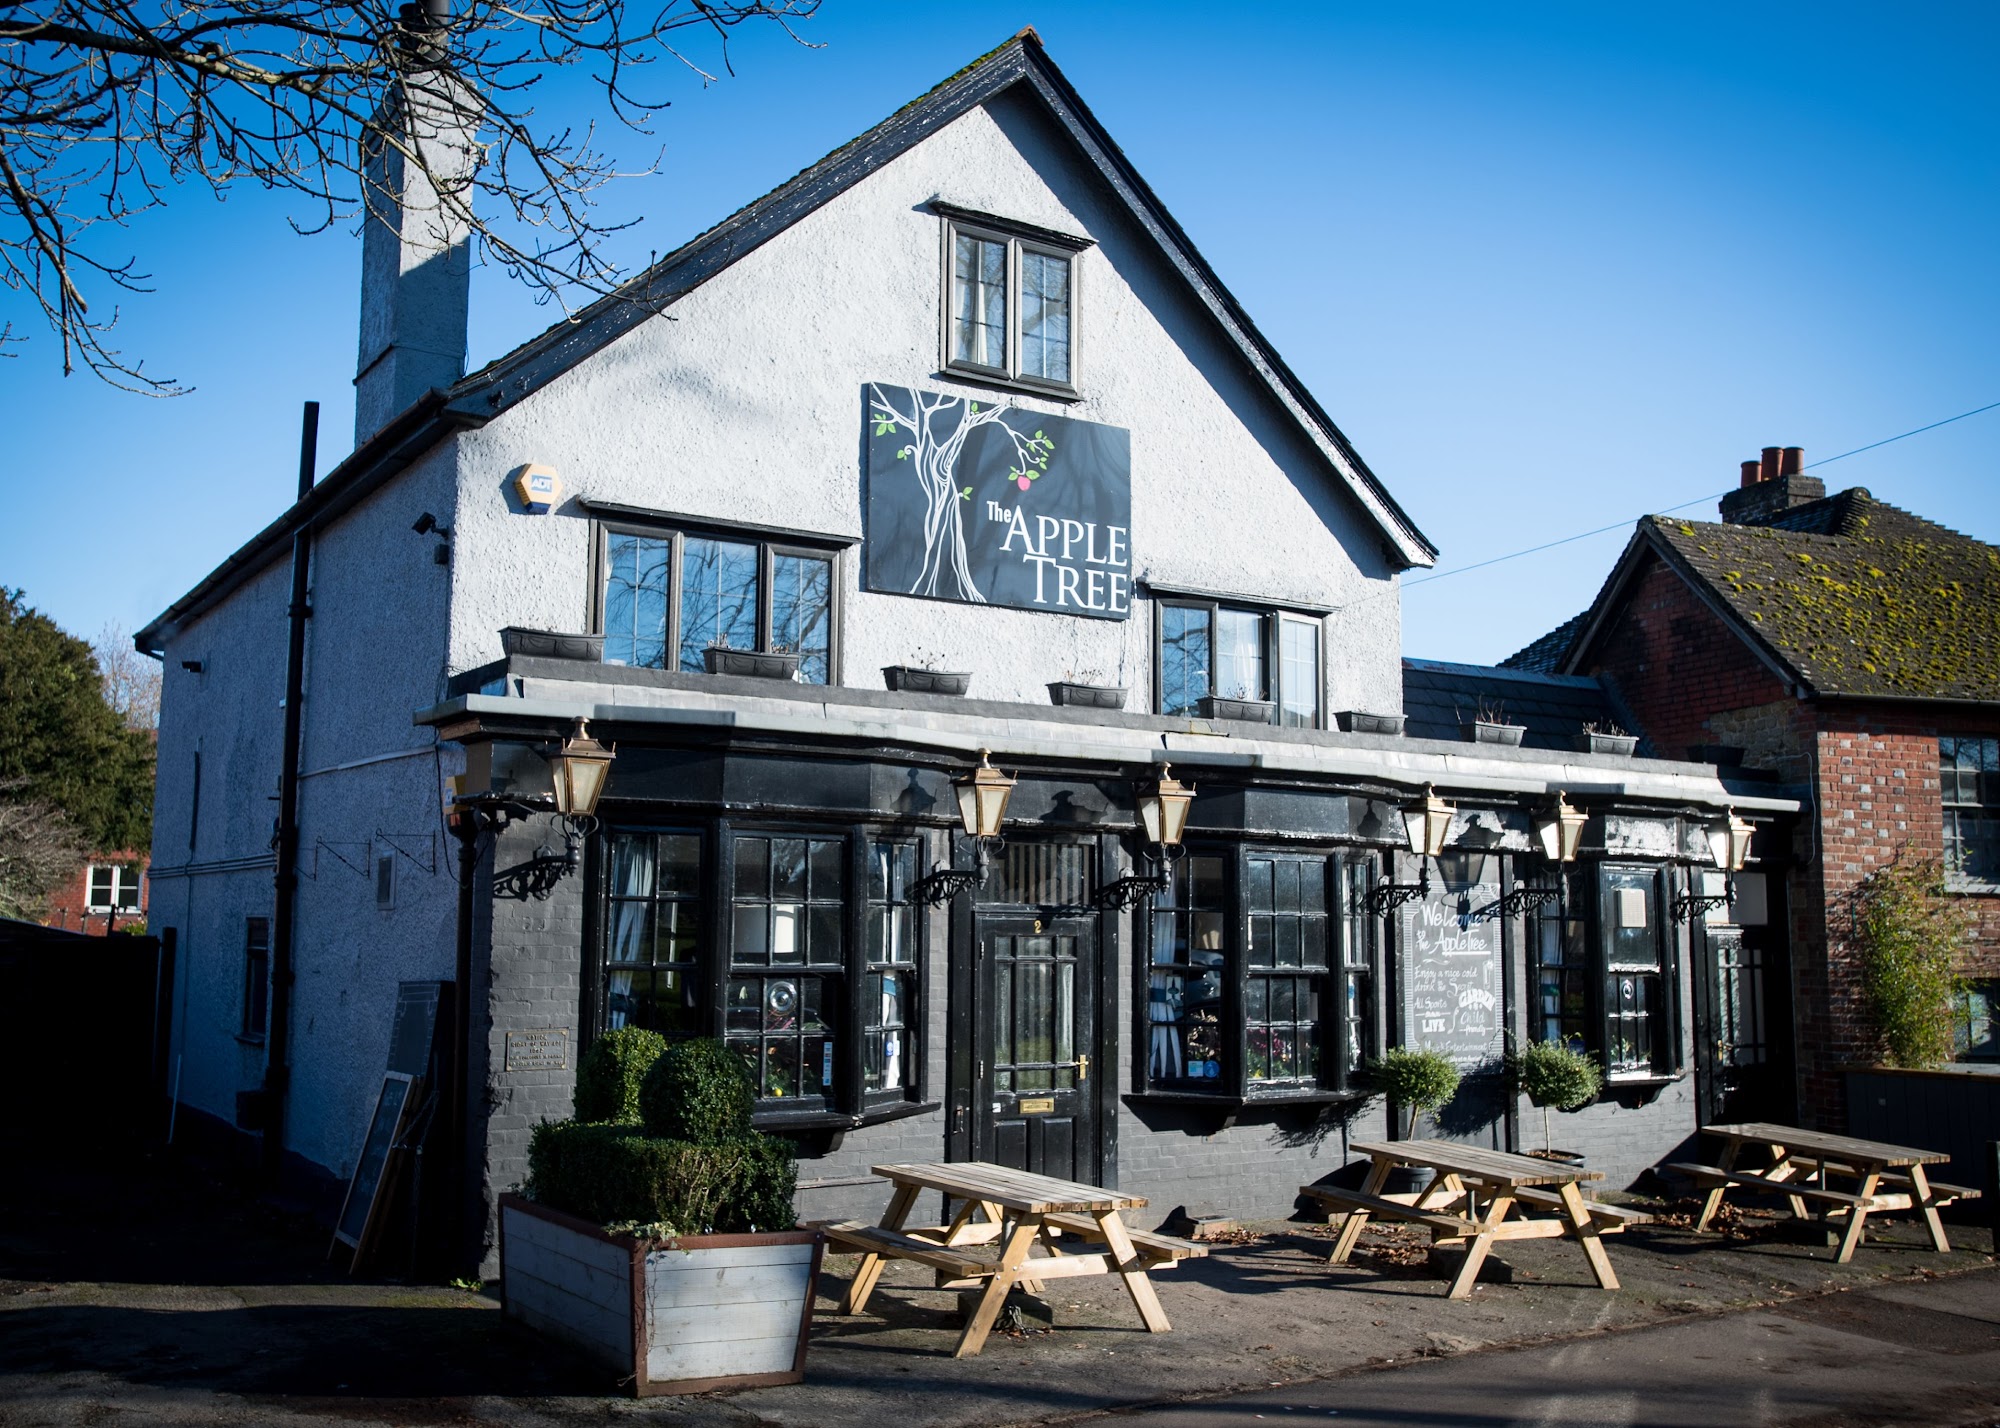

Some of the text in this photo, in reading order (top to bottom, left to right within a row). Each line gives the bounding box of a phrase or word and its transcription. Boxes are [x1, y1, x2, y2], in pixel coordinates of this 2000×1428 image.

[531, 477, 552, 490] ADT
[986, 500, 1128, 567] The APPLE
[1022, 553, 1128, 613] TREE
[1421, 901, 1481, 927] Welcome
[1034, 920, 1042, 934] 2
[1414, 965, 1436, 984] Enjoy
[1444, 967, 1460, 978] nice
[1461, 966, 1478, 978] cold
[1415, 981, 1435, 992] drink
[1425, 996, 1447, 1010] Sports
[1460, 1011, 1485, 1025] Child
[1422, 1019, 1446, 1033] LIVE
